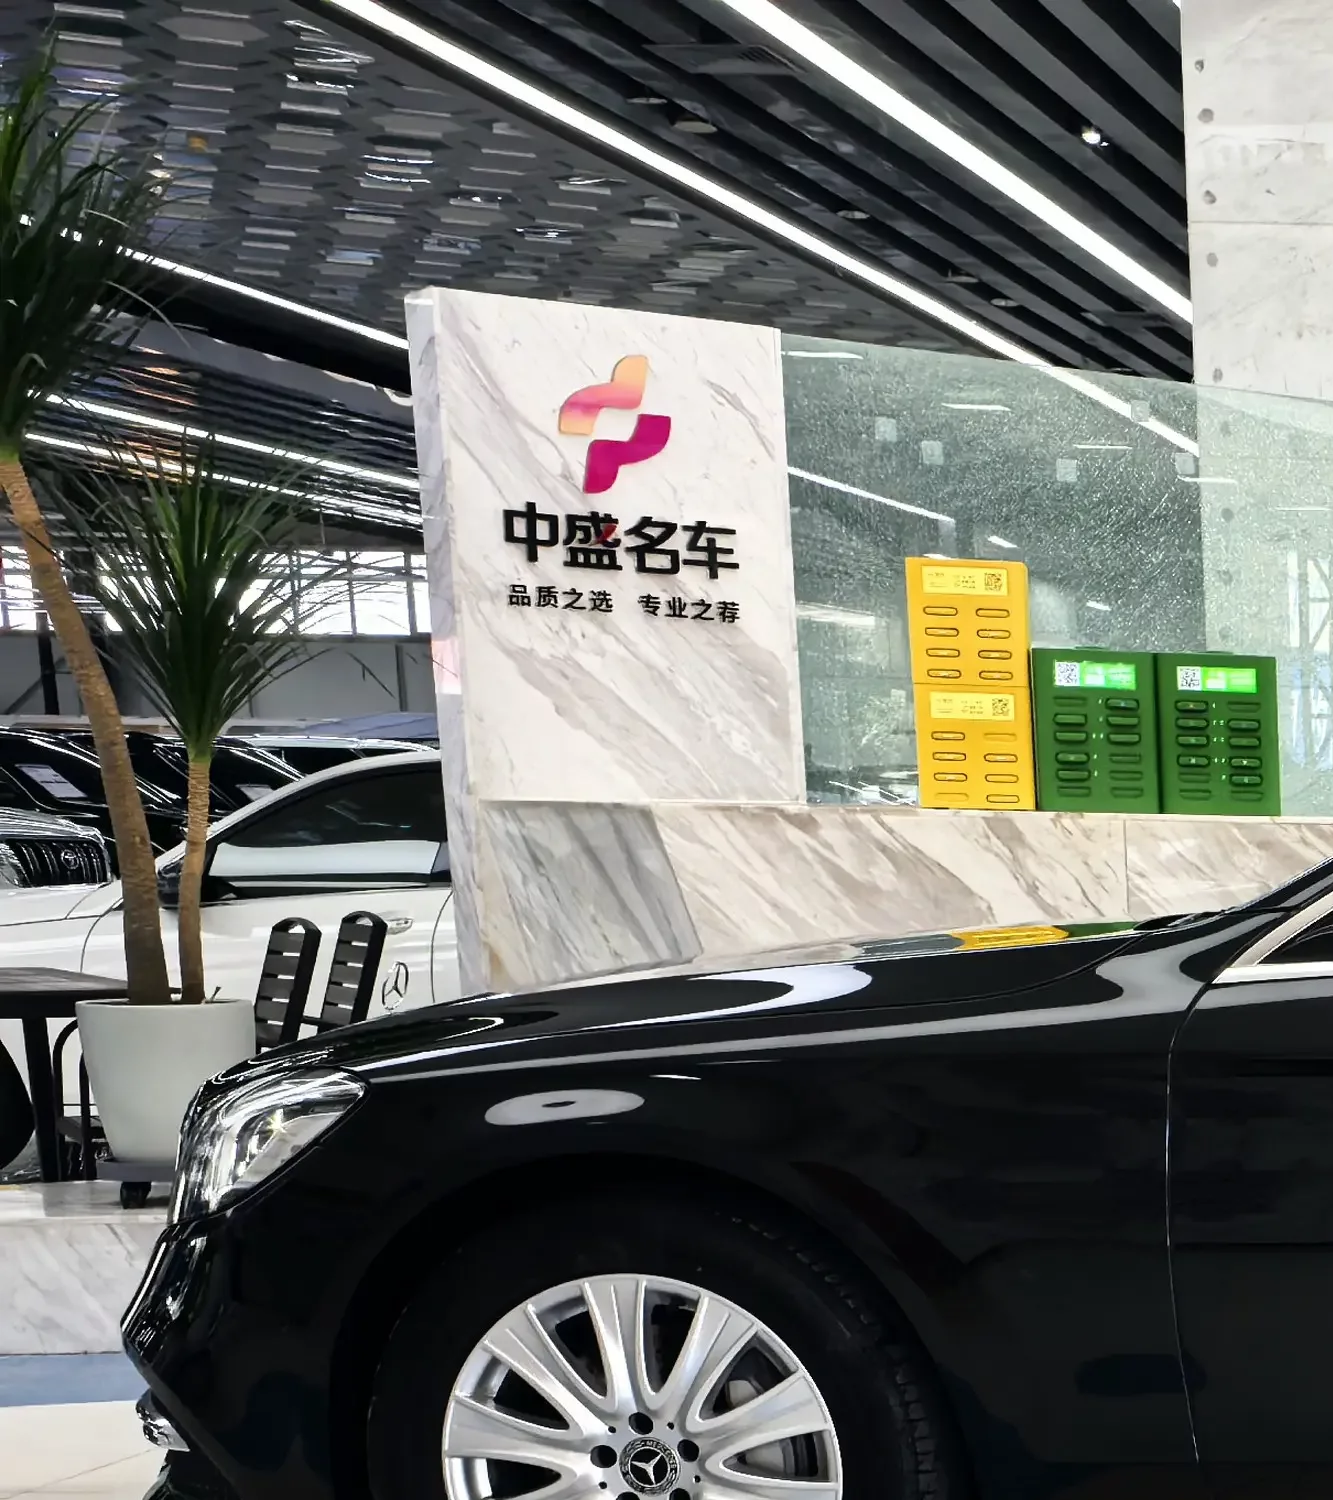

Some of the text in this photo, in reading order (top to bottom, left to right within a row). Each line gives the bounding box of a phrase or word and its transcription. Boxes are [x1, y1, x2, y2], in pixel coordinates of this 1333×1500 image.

[503, 501, 740, 580] 中盛名车
[507, 583, 741, 624] 品质之选 专业之荐
